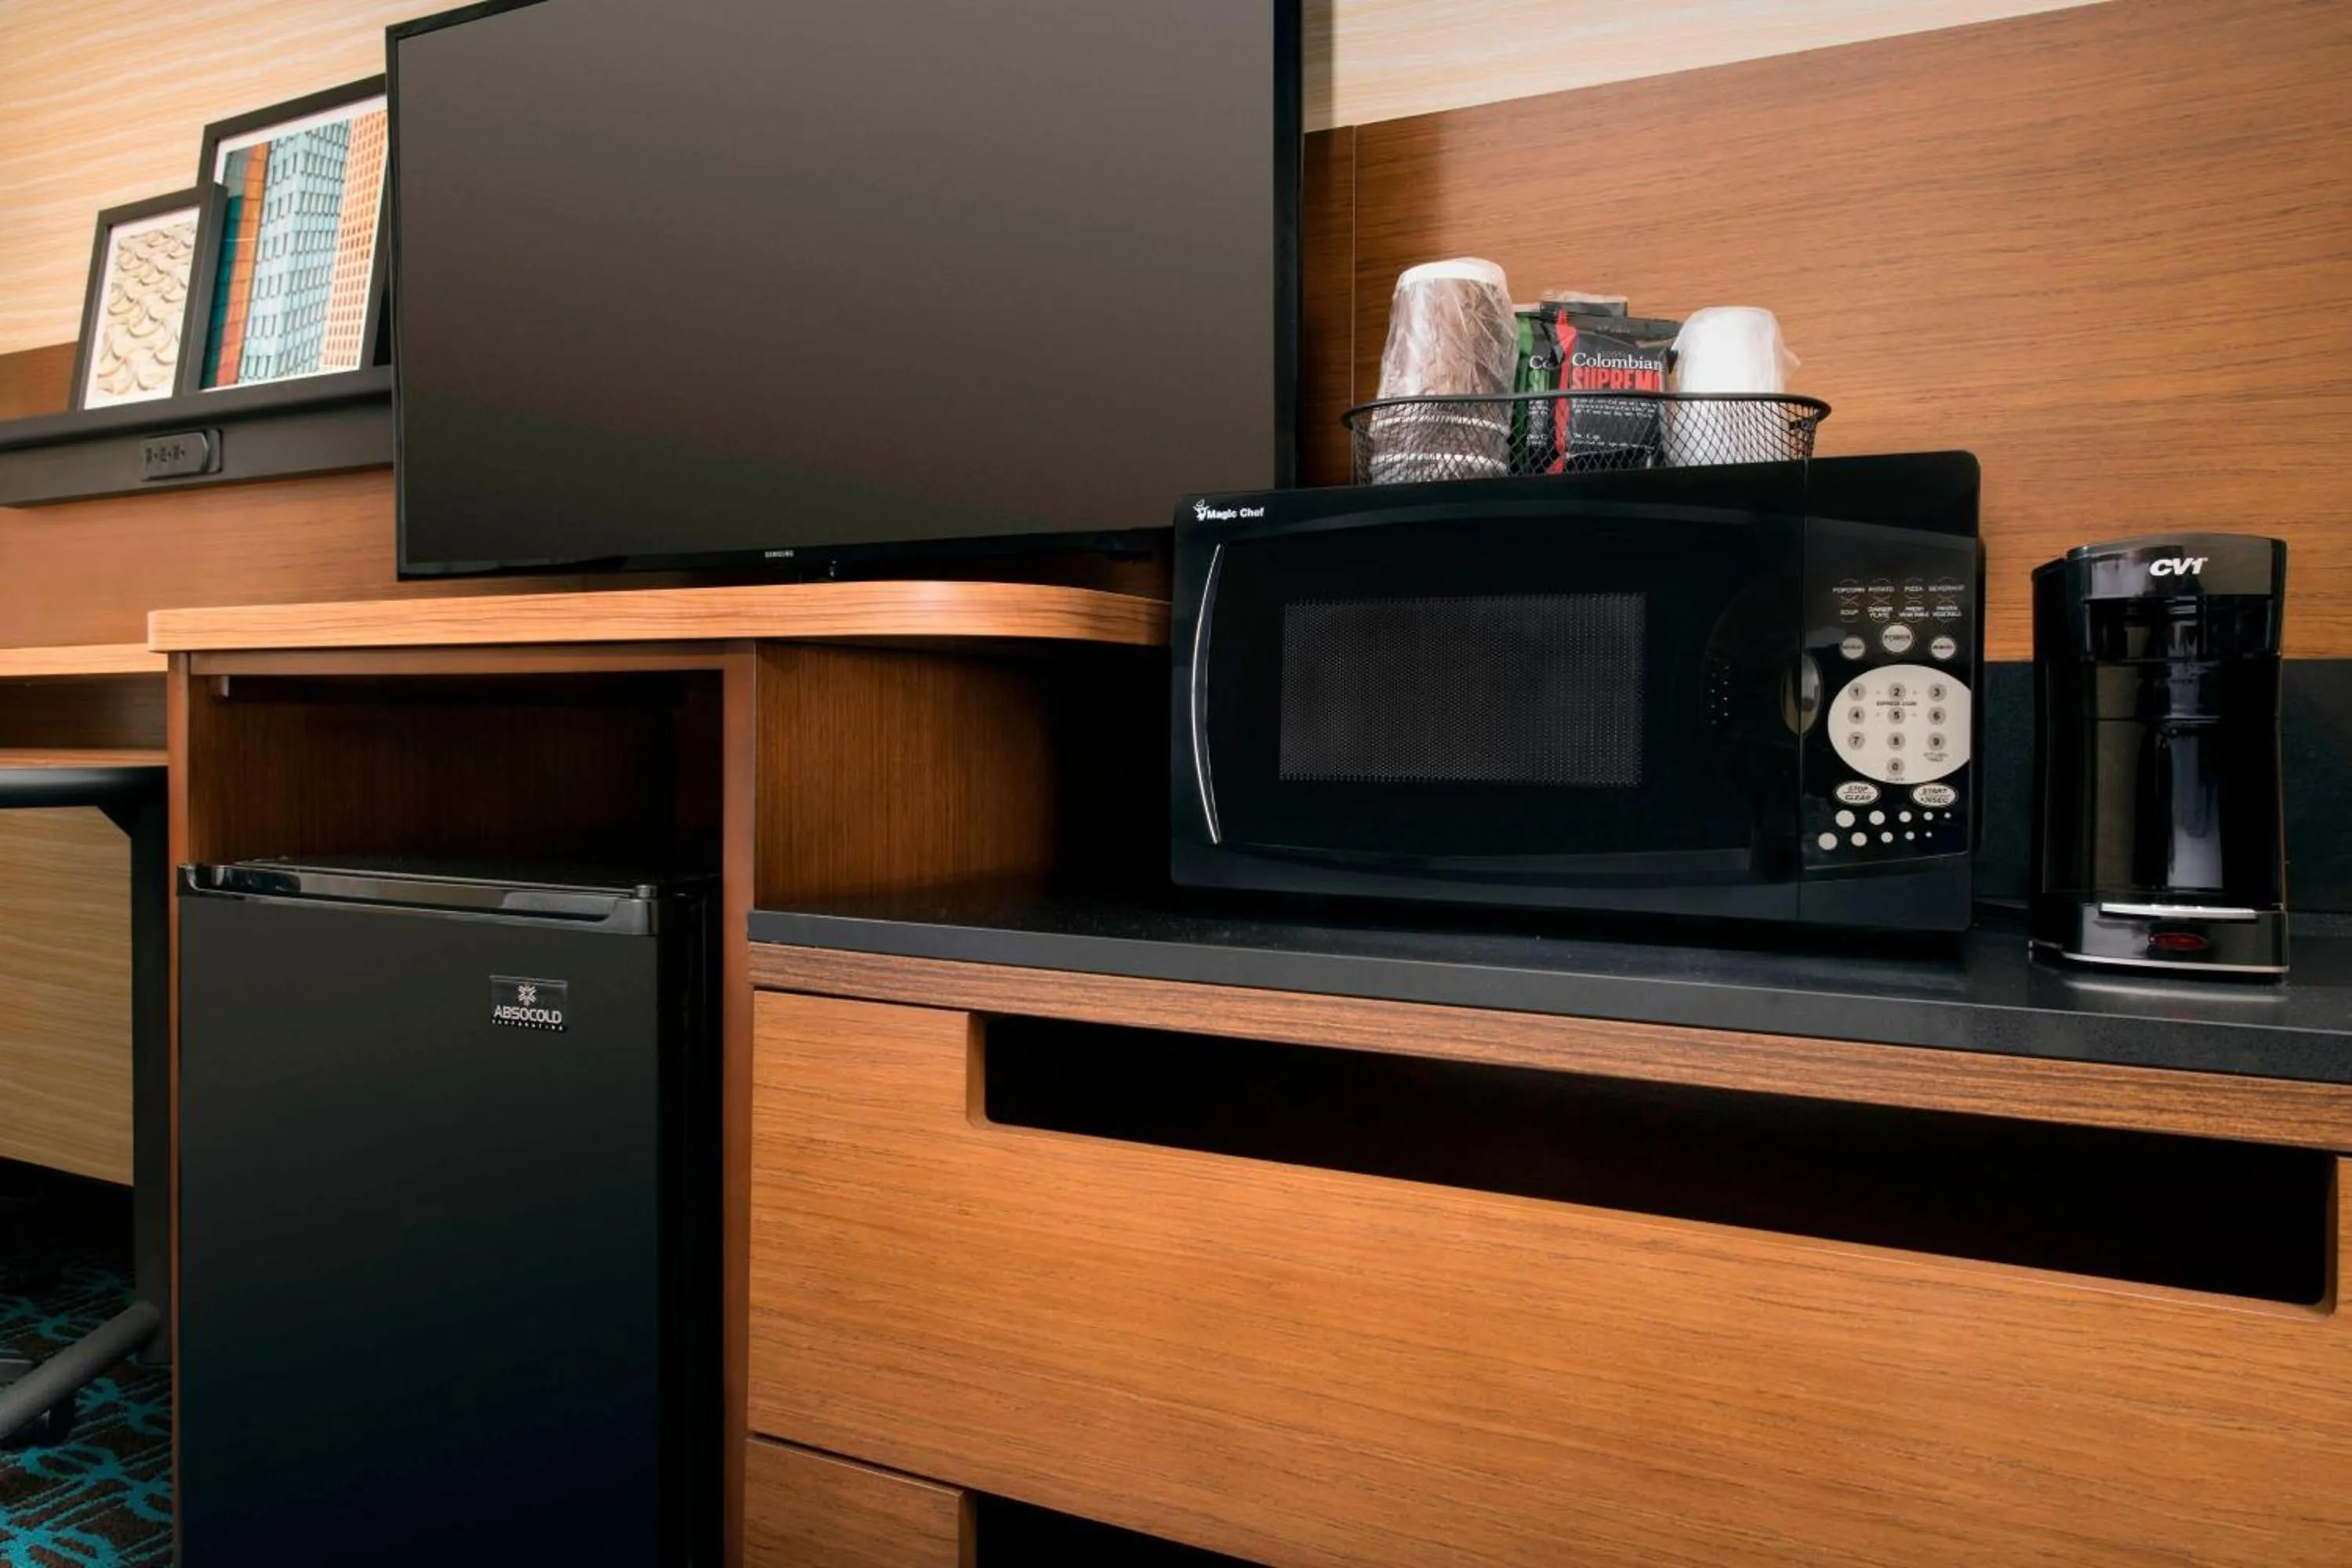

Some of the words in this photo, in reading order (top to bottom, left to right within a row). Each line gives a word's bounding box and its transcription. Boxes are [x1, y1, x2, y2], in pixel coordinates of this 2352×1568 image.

[1572, 352, 1662, 370] Colombian
[1207, 509, 1237, 521] Magic
[1240, 507, 1265, 518] Chef
[1853, 688, 1860, 697] 1
[1893, 688, 1900, 697] 2
[1933, 688, 1940, 697] 3
[1853, 710, 1860, 720] 4
[1893, 711, 1900, 720] 5
[1933, 711, 1940, 720] 6
[1853, 735, 1860, 745] 7
[1893, 736, 1900, 746] 8
[1933, 737, 1940, 746] 9
[1891, 763, 1899, 771] 0
[493, 1004, 563, 1024] ABSOCOLD
